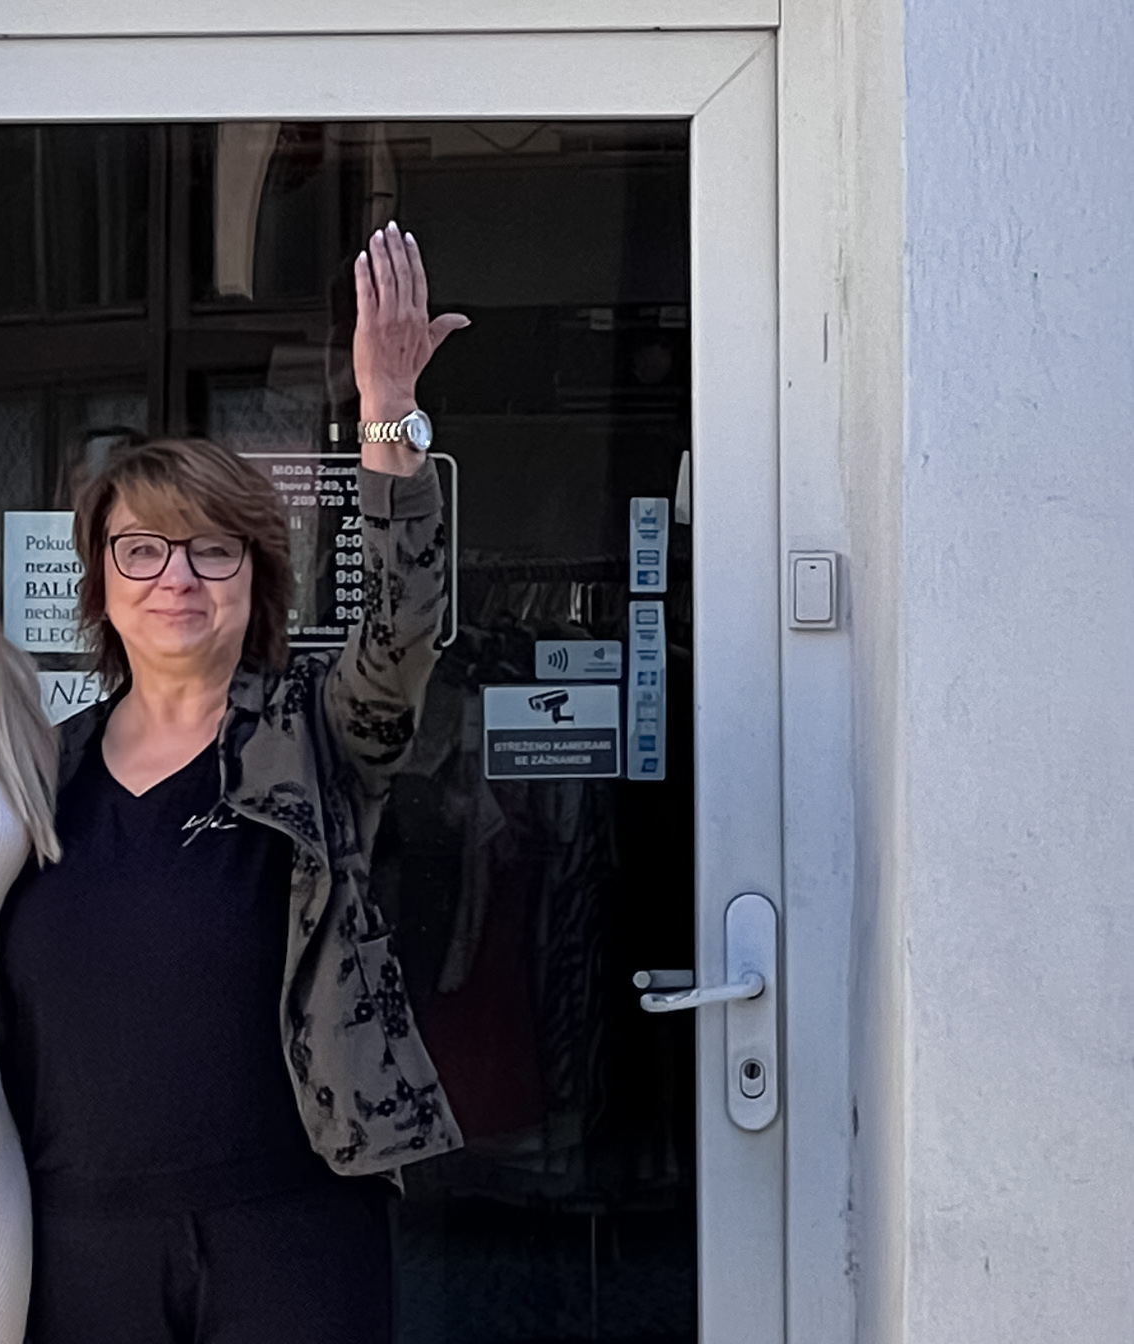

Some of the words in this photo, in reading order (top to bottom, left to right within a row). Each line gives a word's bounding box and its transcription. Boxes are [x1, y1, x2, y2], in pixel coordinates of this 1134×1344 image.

[271, 465, 313, 476] MODA
[316, 465, 357, 476] Zuzan
[335, 534, 363, 548] 9:0
[335, 552, 363, 566] 9:0
[335, 570, 363, 584] 9:0
[335, 588, 363, 602] 9:0
[335, 606, 363, 620] 9:0
[25, 627, 74, 643] ELEG
